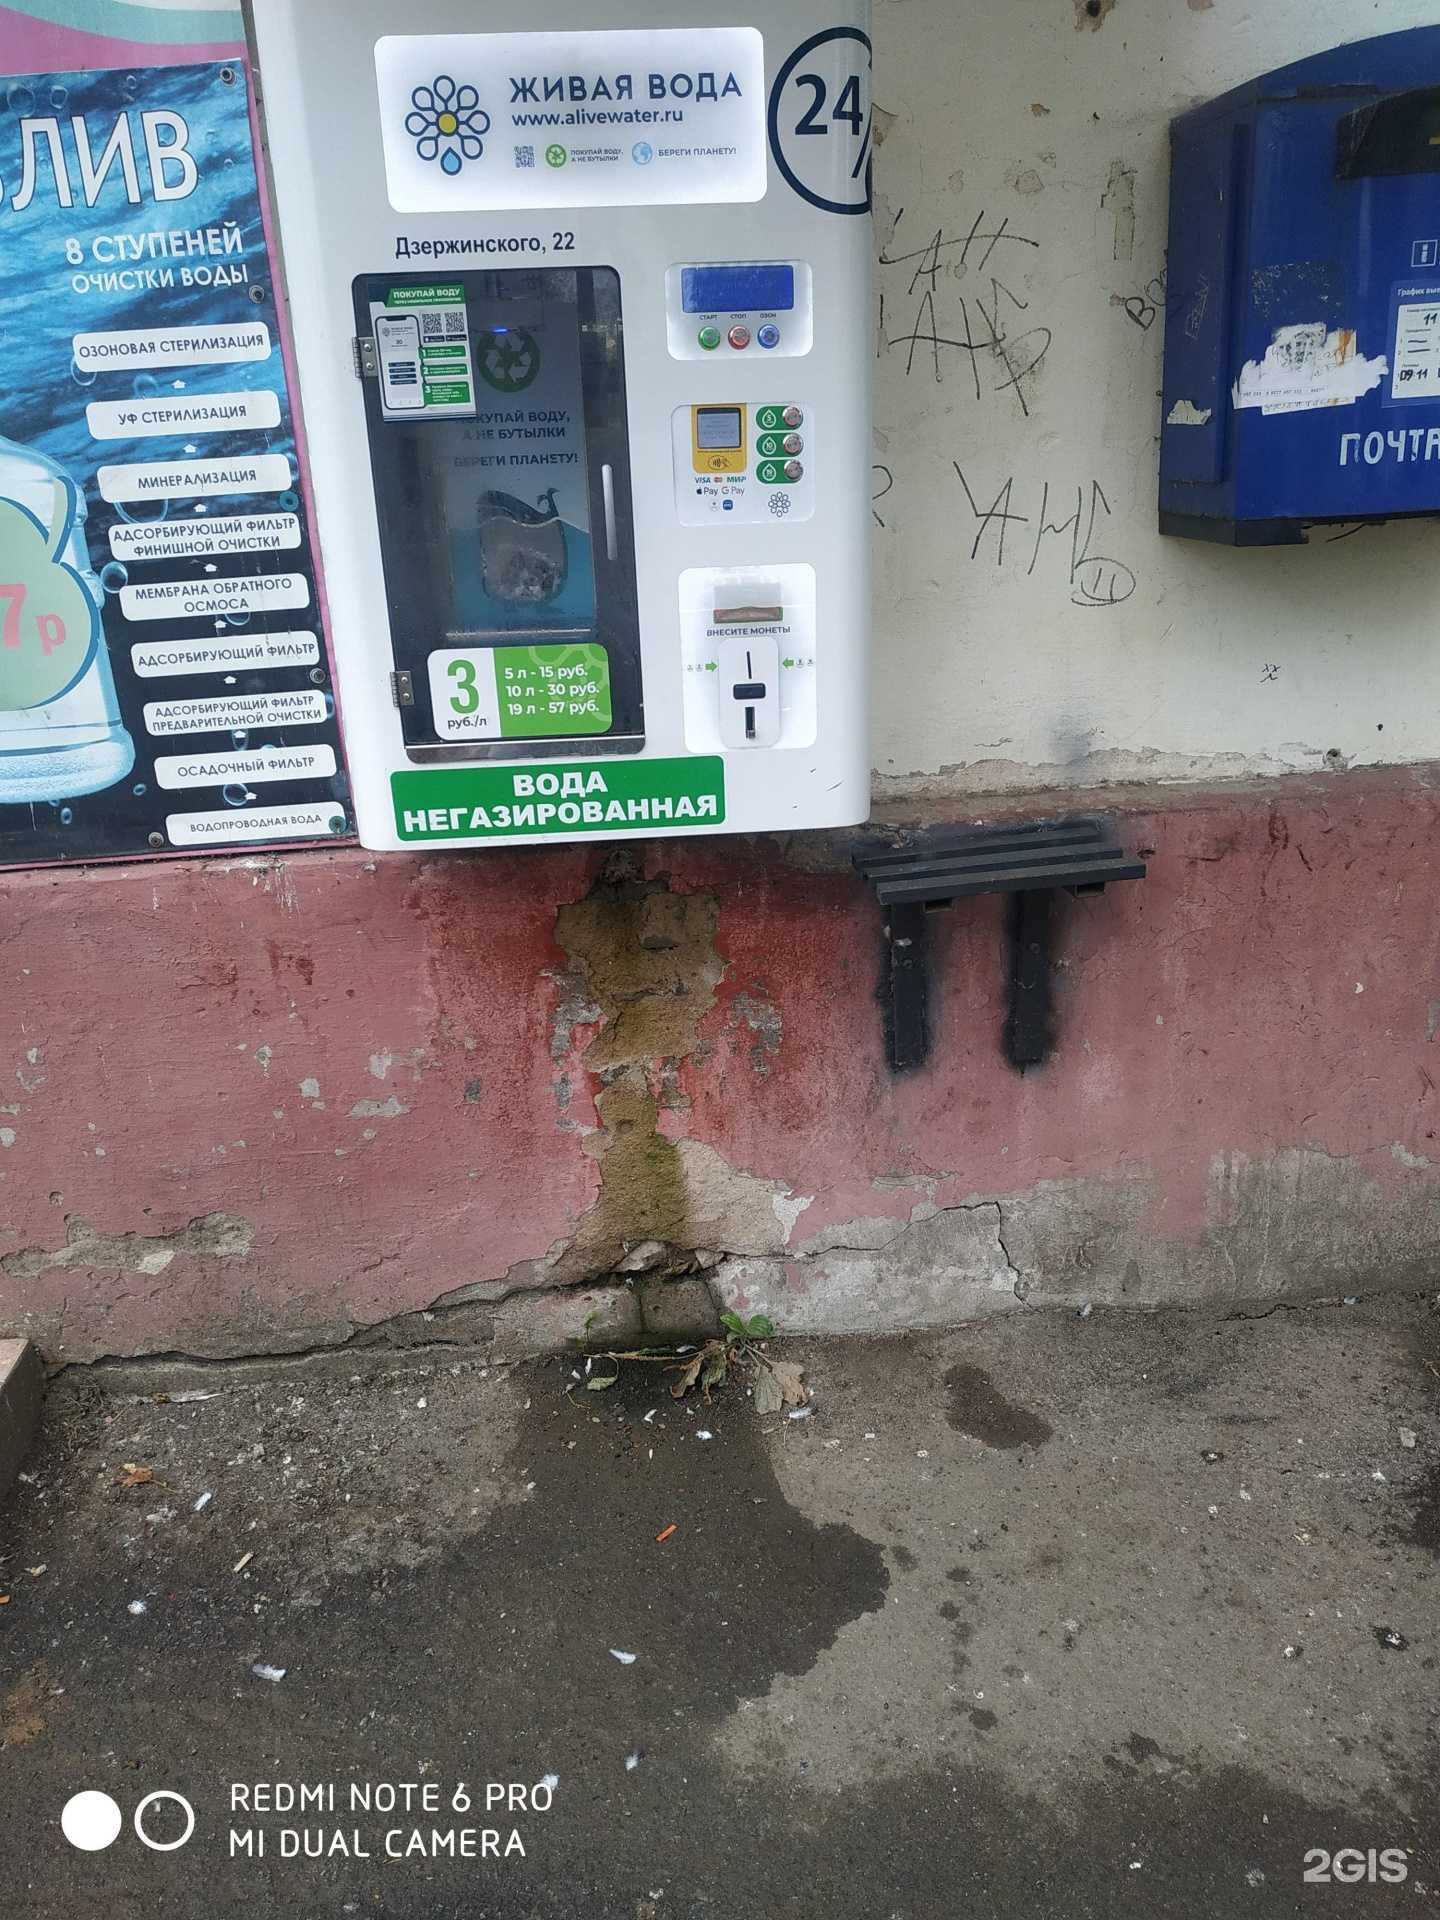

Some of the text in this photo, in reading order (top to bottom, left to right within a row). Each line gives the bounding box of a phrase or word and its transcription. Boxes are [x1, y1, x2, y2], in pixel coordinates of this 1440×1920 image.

[510, 72, 742, 103] ЖИВАЯ ВОДА
[512, 108, 683, 127] www.alivewater.ru
[0, 110, 199, 212] ЛИВ
[658, 147, 736, 157] БЕРЕГИ ПЛАНЕТУ!
[65, 221, 243, 265] 8 СТУПЕНЕЙ
[395, 232, 575, 259] Дзержинского, 22
[72, 264, 248, 295] ОЧИСТКИ ВОДЫ
[393, 288, 434, 299] ПОКУПАЙ
[79, 335, 264, 359] ОЗОНОВАЯ СТЕРИЛИЗАЦИЯ
[118, 405, 247, 426] УФ СТЕРИЛИЗАЦИЯ
[528, 411, 570, 423] ВОДУ,
[499, 427, 565, 439] БУТЫЛКИ
[510, 453, 578, 465] ПЛАНЕТУ!
[137, 470, 257, 489] МИНЕРАЛИЗАЦИЯ
[704, 487, 718, 496] Pay
[731, 486, 745, 496] Pay
[113, 517, 296, 542] АДСОРБИРУЮЩИЙ ФИЛЬТР
[133, 535, 280, 557] ФИНИШНОЙ ОЧИСТКИ
[135, 578, 292, 600] МЕМБРАНА ОБРАТНОГО
[184, 597, 249, 613] ОСМОСА
[706, 626, 790, 637] ВНЕСИТЕ МОНЕТЫ
[138, 642, 315, 668] АДСОРБИРУЮЩИЙ ФИЛЬТР
[504, 668, 513, 679] 5
[515, 670, 527, 679] л
[539, 667, 553, 678] 15
[556, 665, 588, 681] руб.
[447, 659, 480, 714] 3
[506, 685, 521, 697] 10
[524, 687, 535, 696] л
[547, 684, 566, 695] 30
[569, 682, 600, 699] руб.
[155, 695, 314, 718] АДСОРБИРУЮЩИЙ ФИЛЬТР
[508, 703, 523, 715] 19
[526, 705, 536, 714] л
[548, 702, 565, 714] 57
[569, 700, 600, 716] руб.
[152, 707, 321, 732] ПРЕДВАРИТЕЛЬНОЙ ОЧИСТКИ
[447, 714, 487, 730] руб./л
[177, 755, 315, 778] ОСАДОЧНЫЙ ФИЛЬТР
[513, 771, 608, 798] ВОДА
[190, 814, 322, 833] ВОДОПРОВОДНАЯ ВОДА
[403, 795, 717, 832] НЕГАЗИРОВАННАЯ
